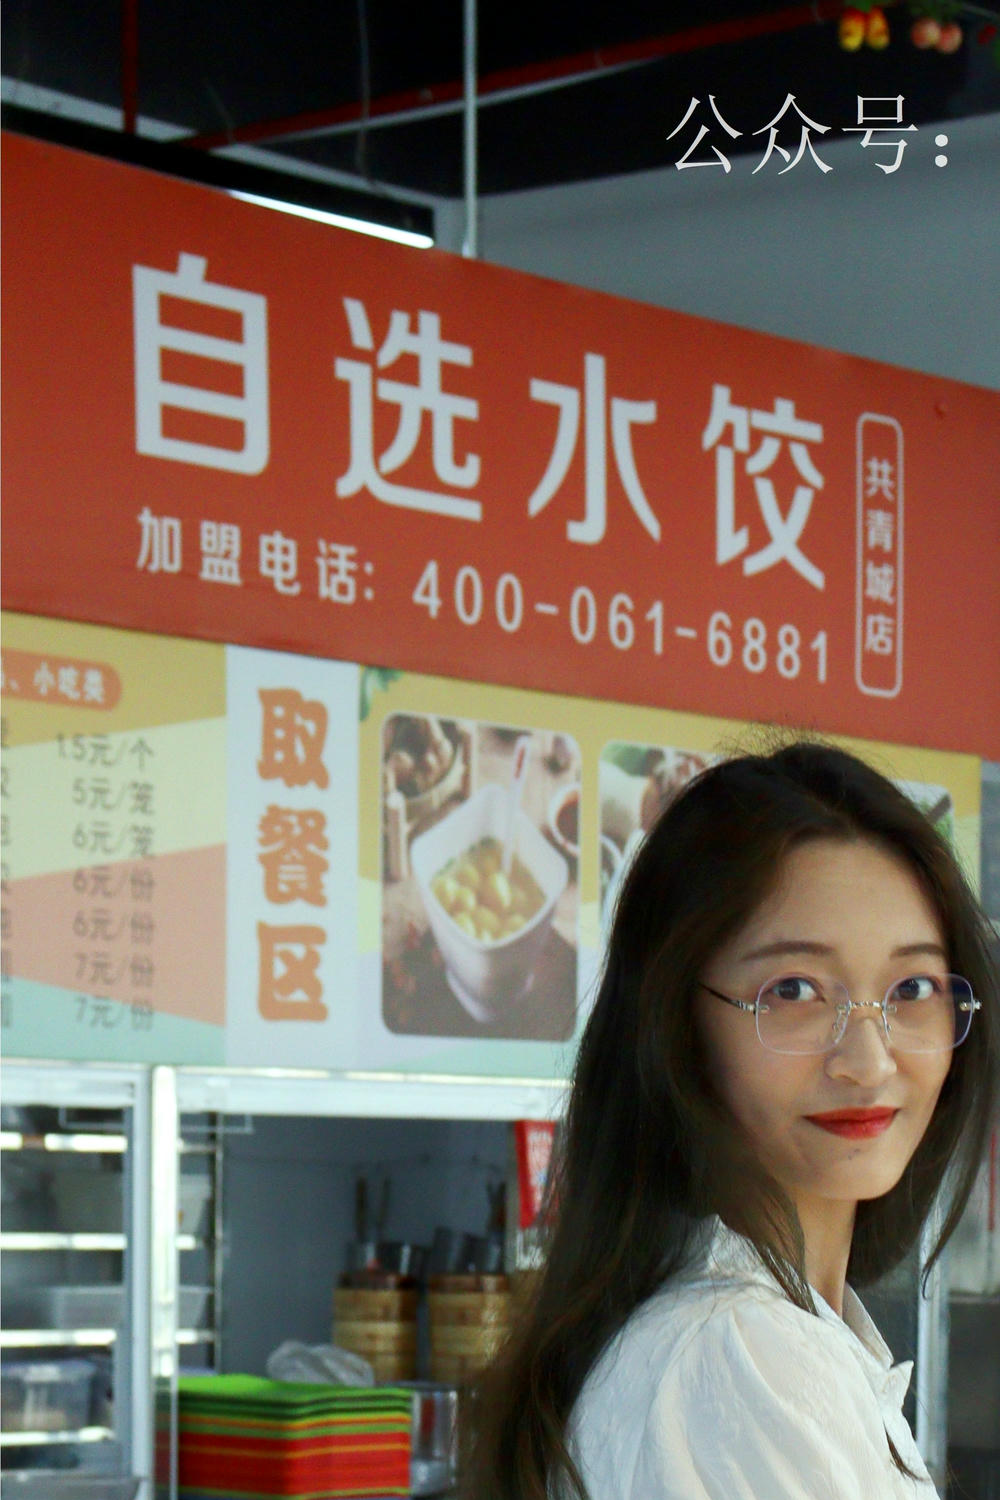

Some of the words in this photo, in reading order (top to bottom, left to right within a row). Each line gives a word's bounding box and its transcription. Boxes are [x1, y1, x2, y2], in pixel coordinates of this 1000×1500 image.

[132, 252, 826, 590] 自选水饺
[864, 458, 896, 656] 共青城店
[256, 687, 331, 1023] 取餐区
